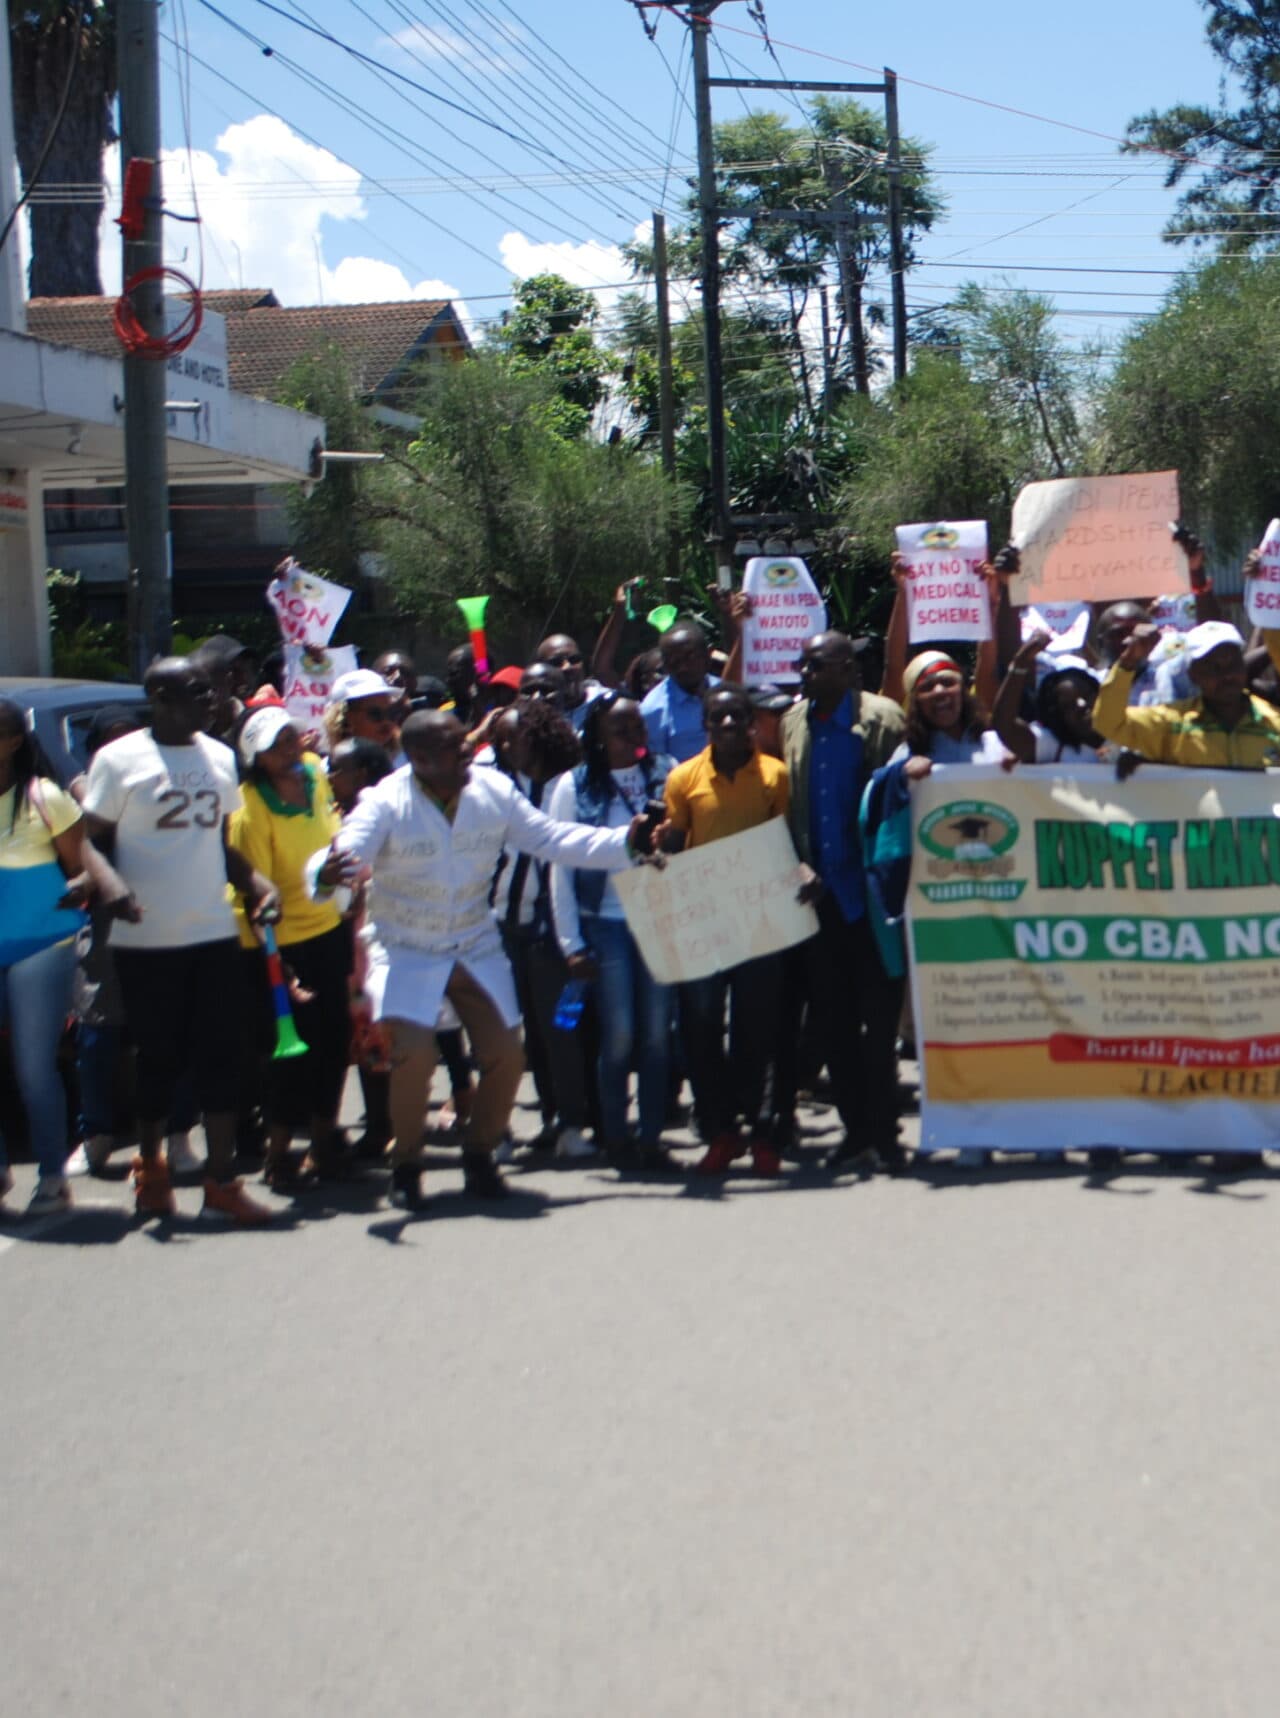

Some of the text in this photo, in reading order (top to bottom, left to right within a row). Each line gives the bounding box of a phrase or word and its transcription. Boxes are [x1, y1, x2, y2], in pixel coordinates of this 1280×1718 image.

[906, 561, 936, 580] SAY
[939, 559, 961, 575] NO
[912, 582, 982, 600] MEDICAL
[759, 614, 809, 629] WATOTO
[917, 607, 980, 625] SCHEME
[289, 679, 330, 698] AO
[156, 789, 221, 830] 23
[1033, 818, 1179, 890] KUPPET
[1014, 920, 1088, 959] NO
[1104, 920, 1208, 960] CBA
[1086, 1039, 1165, 1059] Baridi
[1172, 1043, 1241, 1066] ipewe
